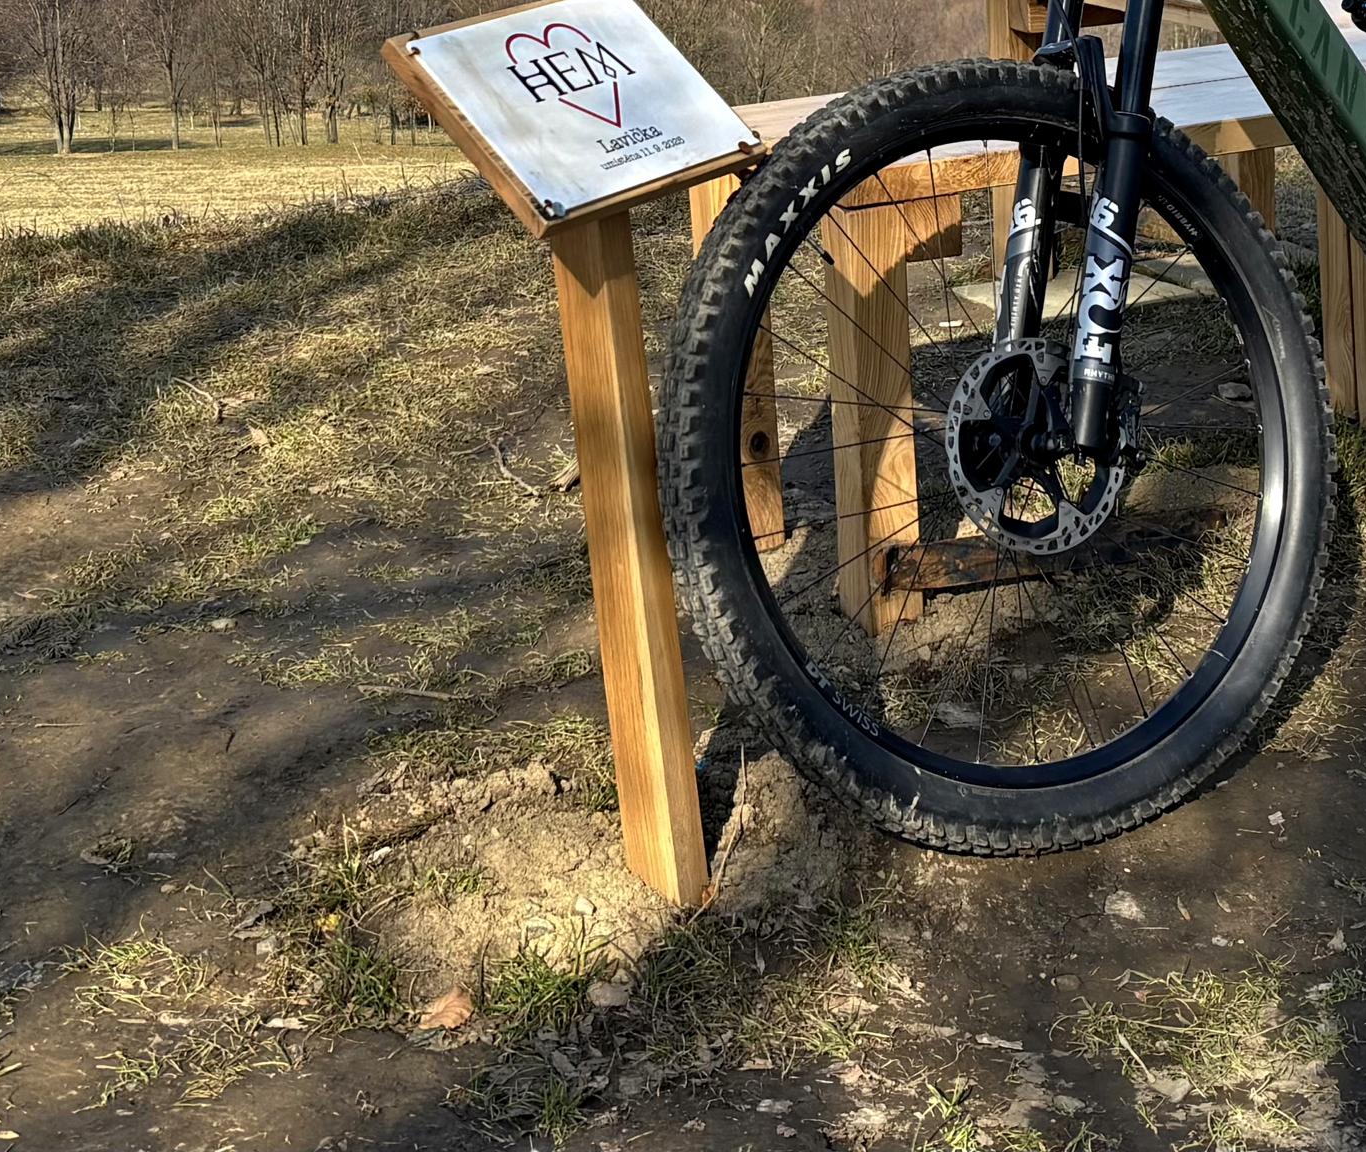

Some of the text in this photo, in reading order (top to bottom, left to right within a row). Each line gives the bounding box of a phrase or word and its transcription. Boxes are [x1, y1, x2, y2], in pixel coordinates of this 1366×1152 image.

[506, 41, 635, 103] HEM
[596, 126, 663, 153] Lavička
[744, 149, 852, 298] MAXXIS
[1074, 255, 1128, 364] FOX
[805, 661, 879, 737] DT SWISS
